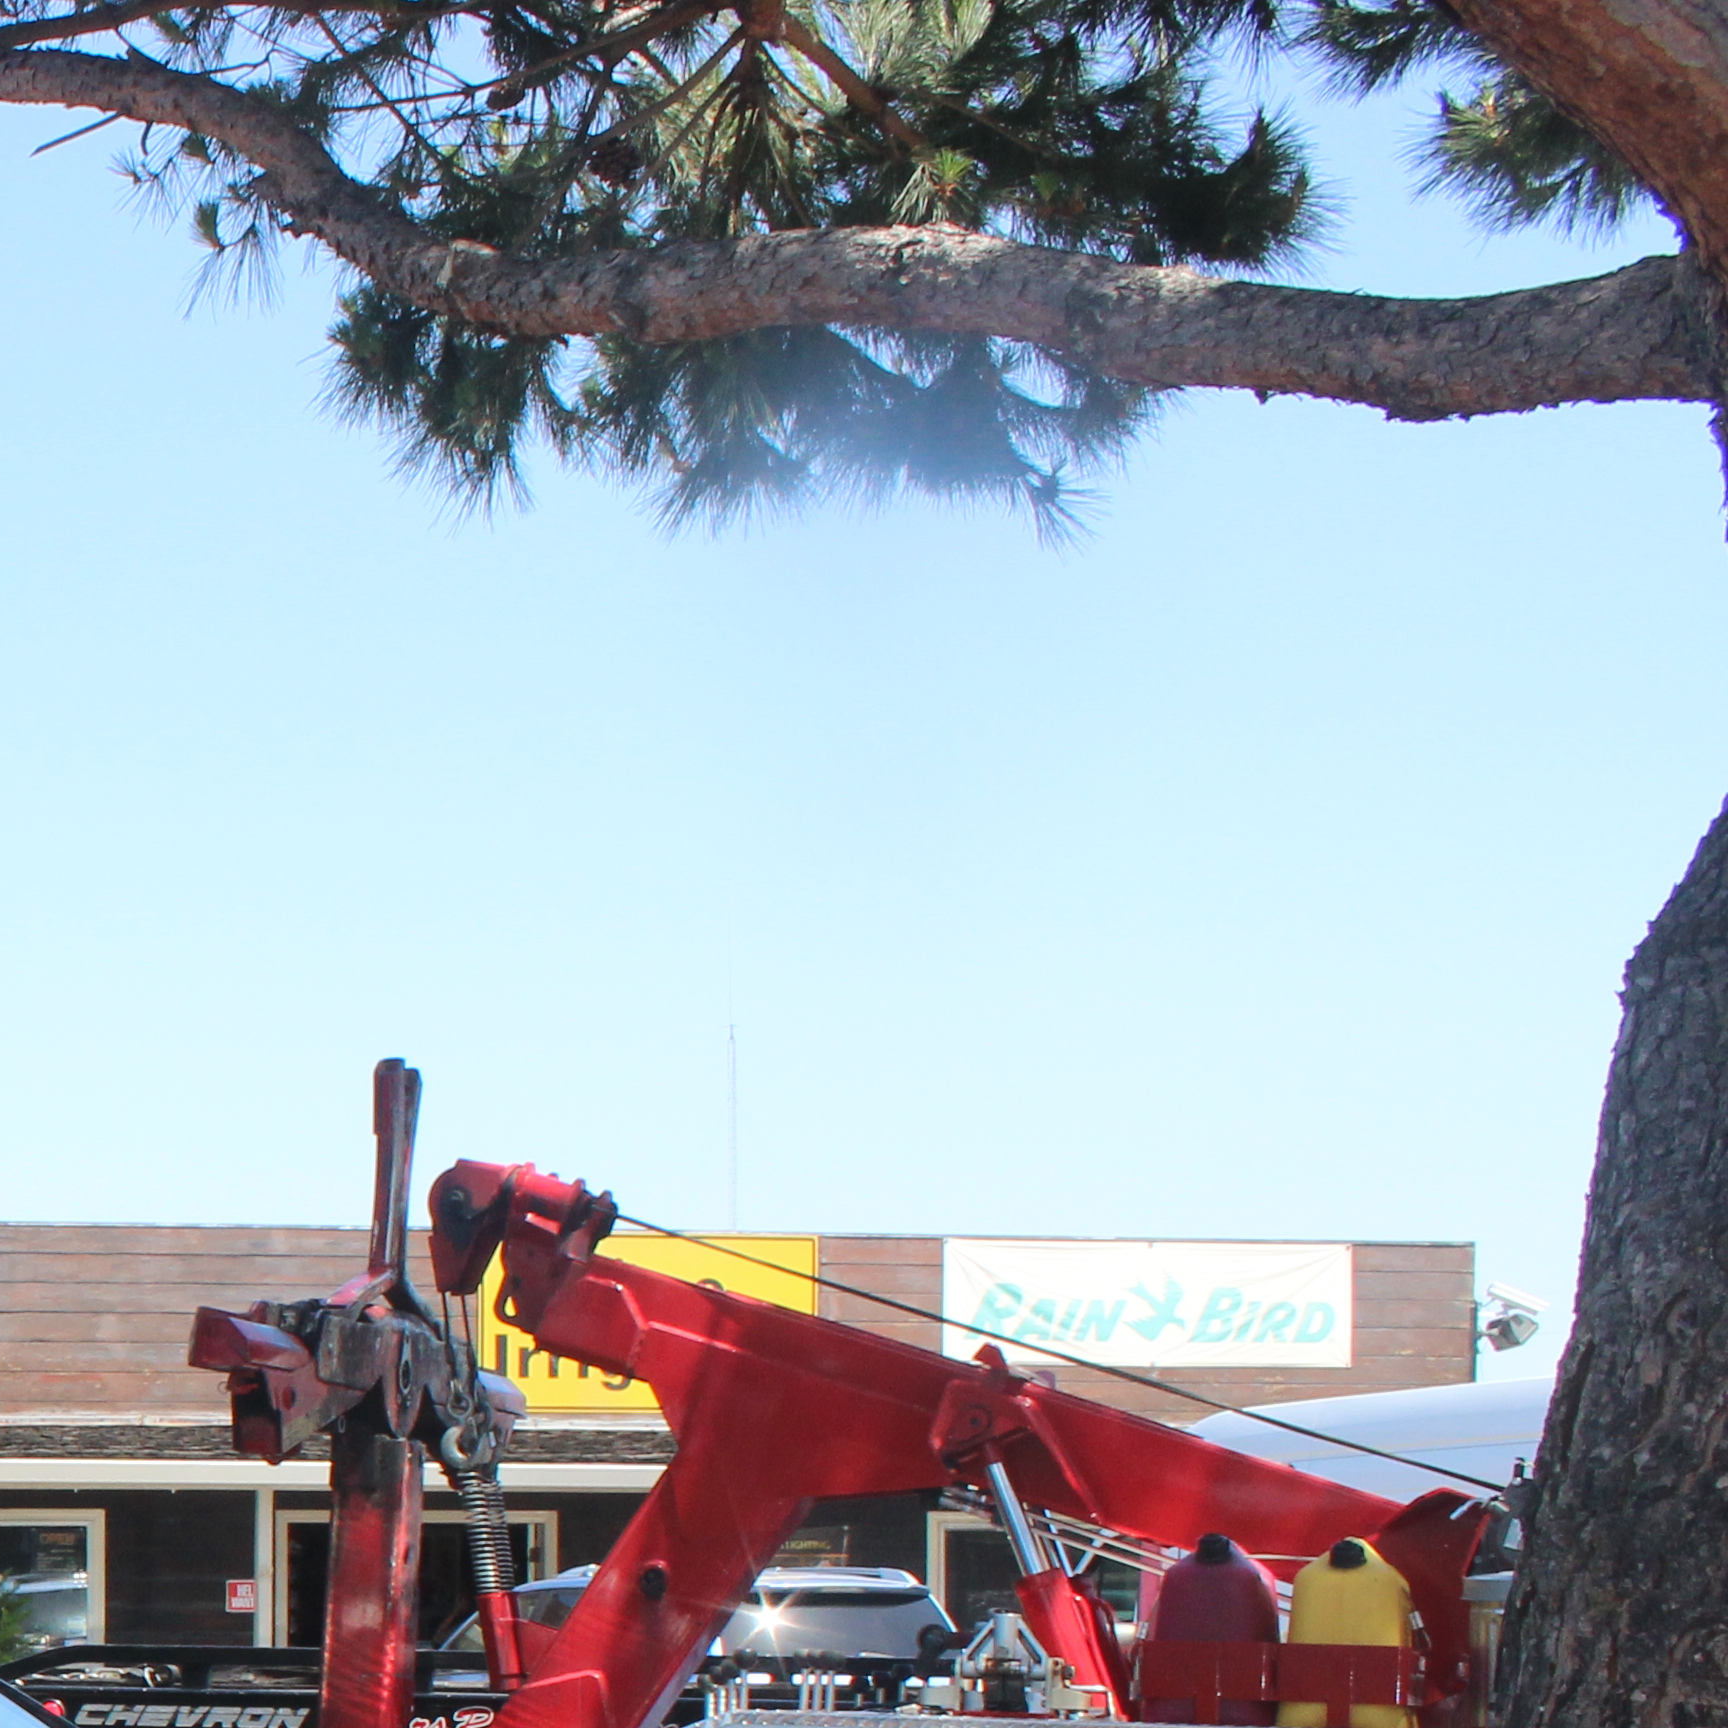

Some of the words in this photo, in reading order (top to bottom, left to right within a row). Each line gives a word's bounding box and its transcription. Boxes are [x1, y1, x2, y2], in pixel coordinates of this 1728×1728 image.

[964, 1283, 1128, 1342] RAIN
[1188, 1287, 1335, 1343] BIRD
[237, 1584, 254, 1597] HEL
